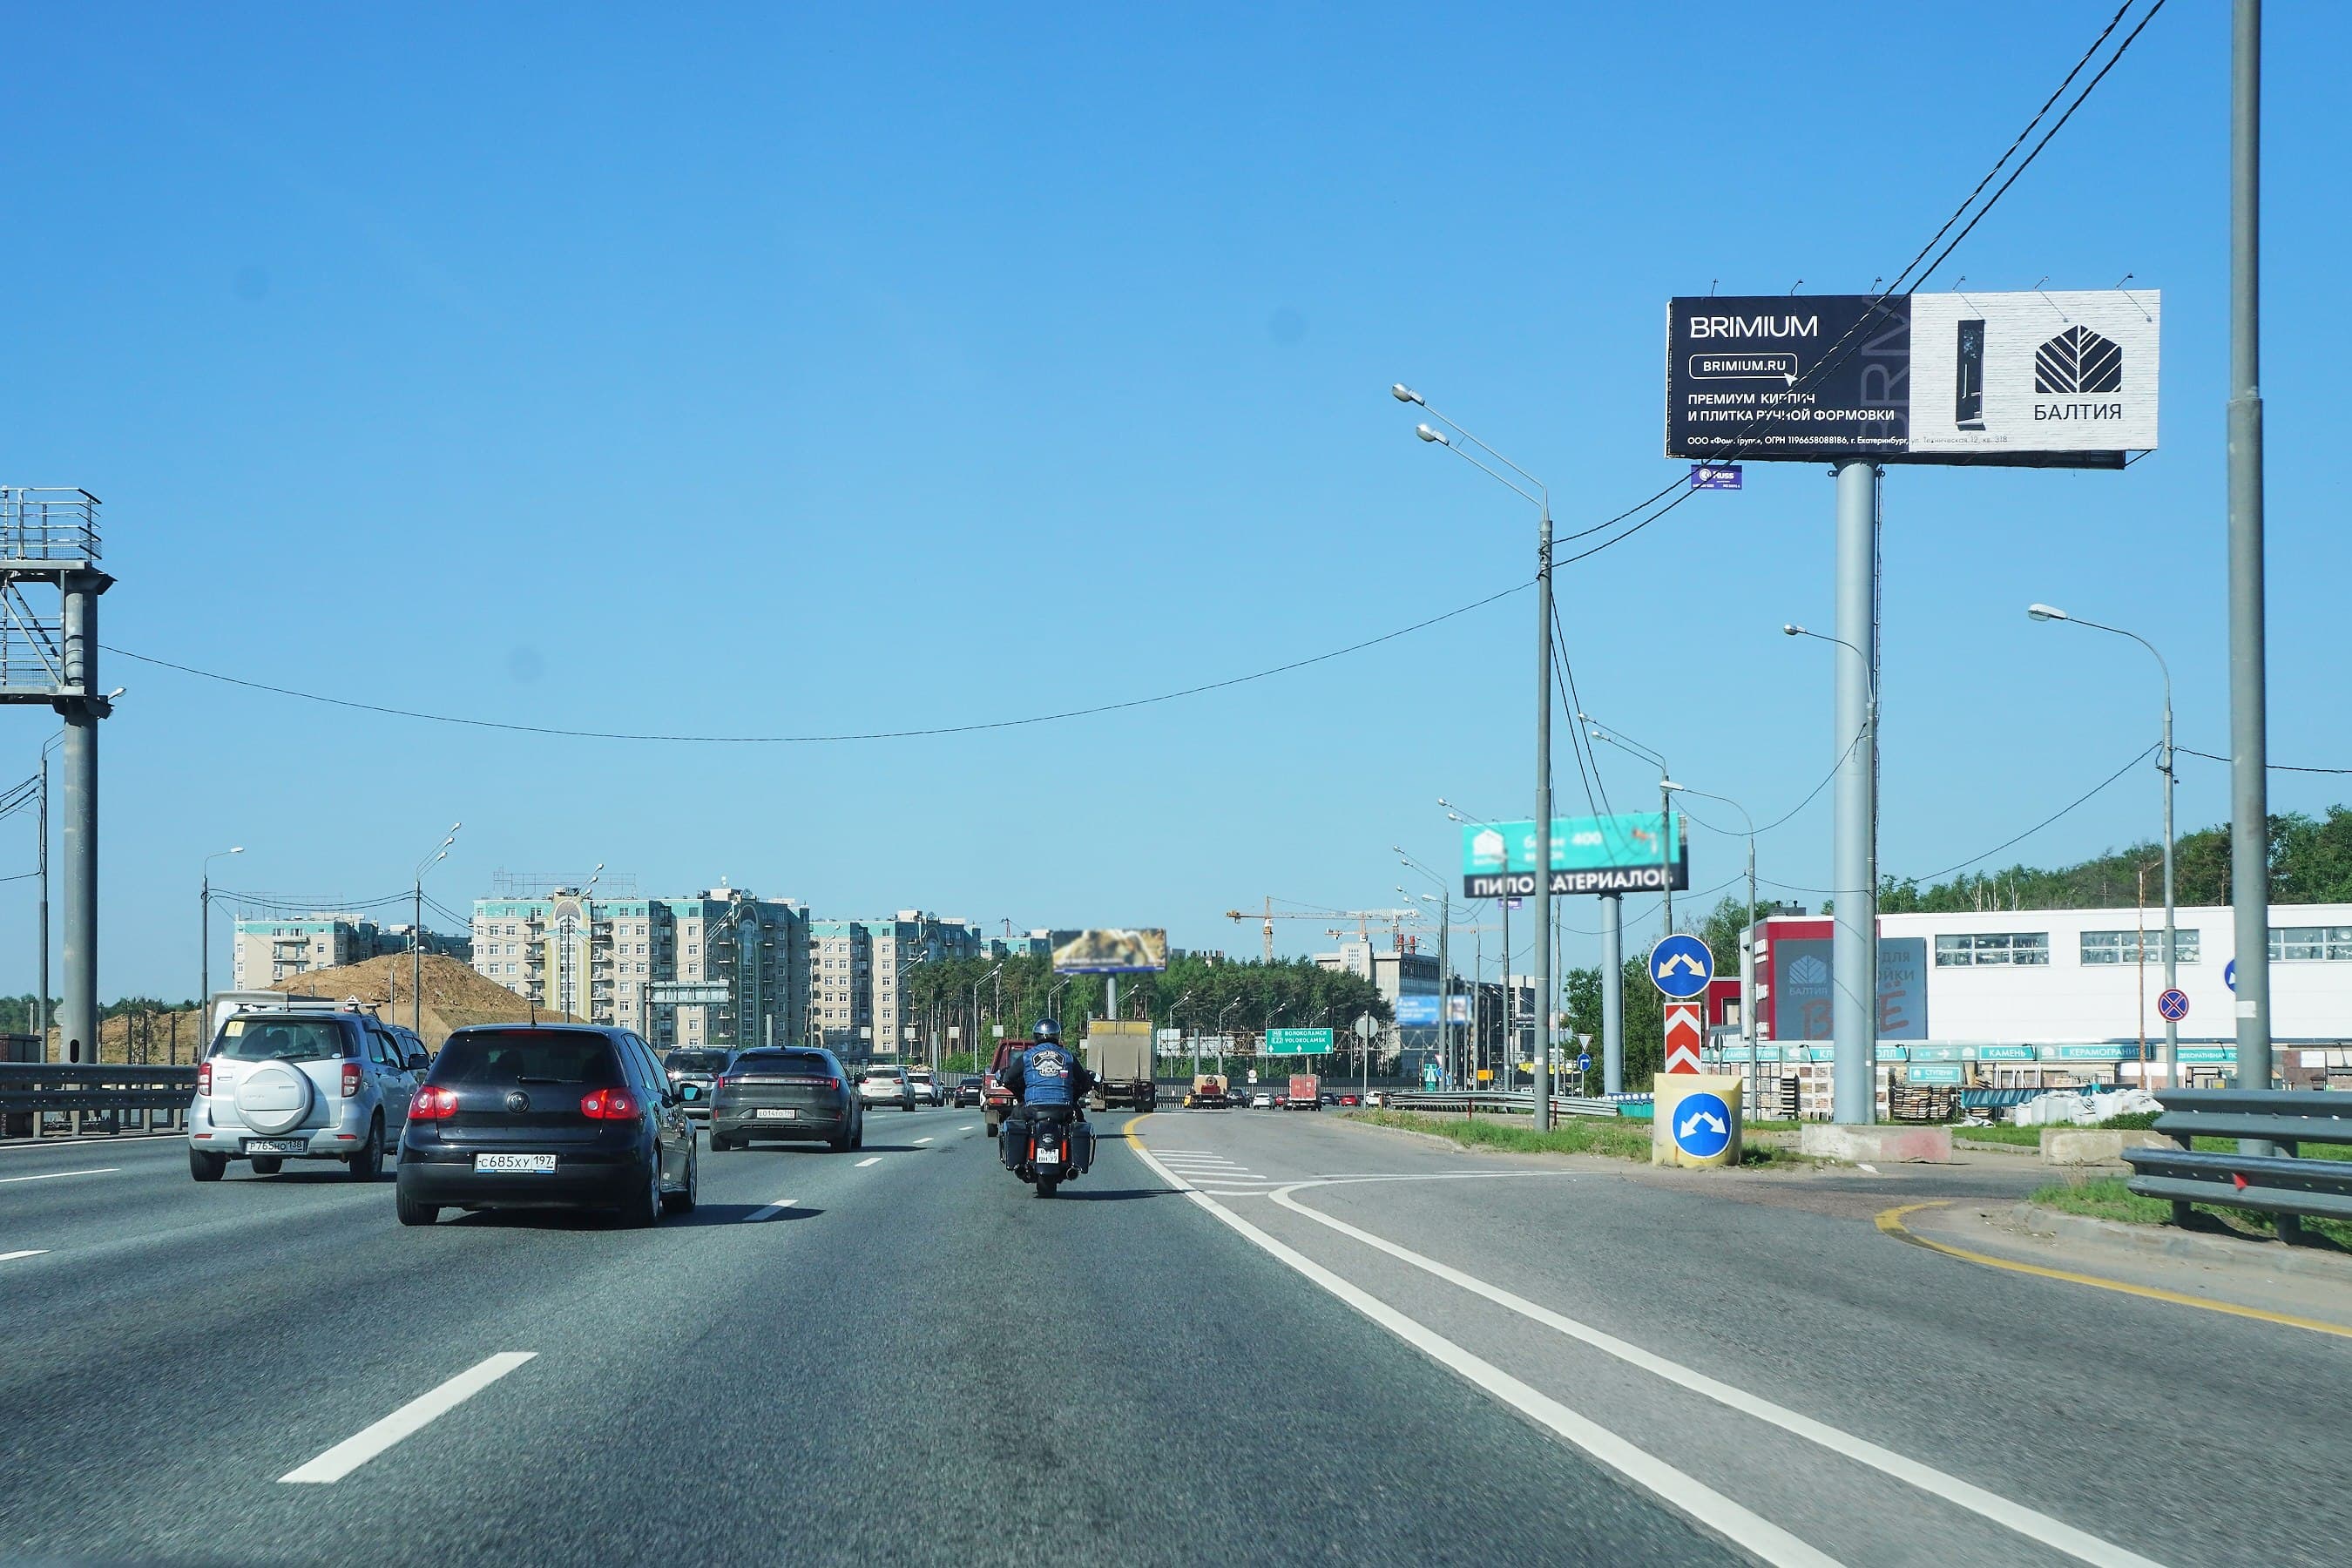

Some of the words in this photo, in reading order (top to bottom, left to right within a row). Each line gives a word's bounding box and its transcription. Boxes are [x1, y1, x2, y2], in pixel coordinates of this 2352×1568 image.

[1690, 315, 1818, 338] BRIMIUM
[1703, 360, 1787, 372] BRIMIUM.RU
[1688, 393, 1755, 405] ПРЕМИУМ
[1687, 410, 1697, 422] И
[1700, 410, 1754, 421] ПЛИТКА
[1814, 409, 1896, 421] ФОРМОВКИ
[2034, 403, 2122, 421] БАЛТИЯ
[1687, 436, 1709, 445] ООО
[1989, 1049, 2026, 1058] КАМЕНЬ
